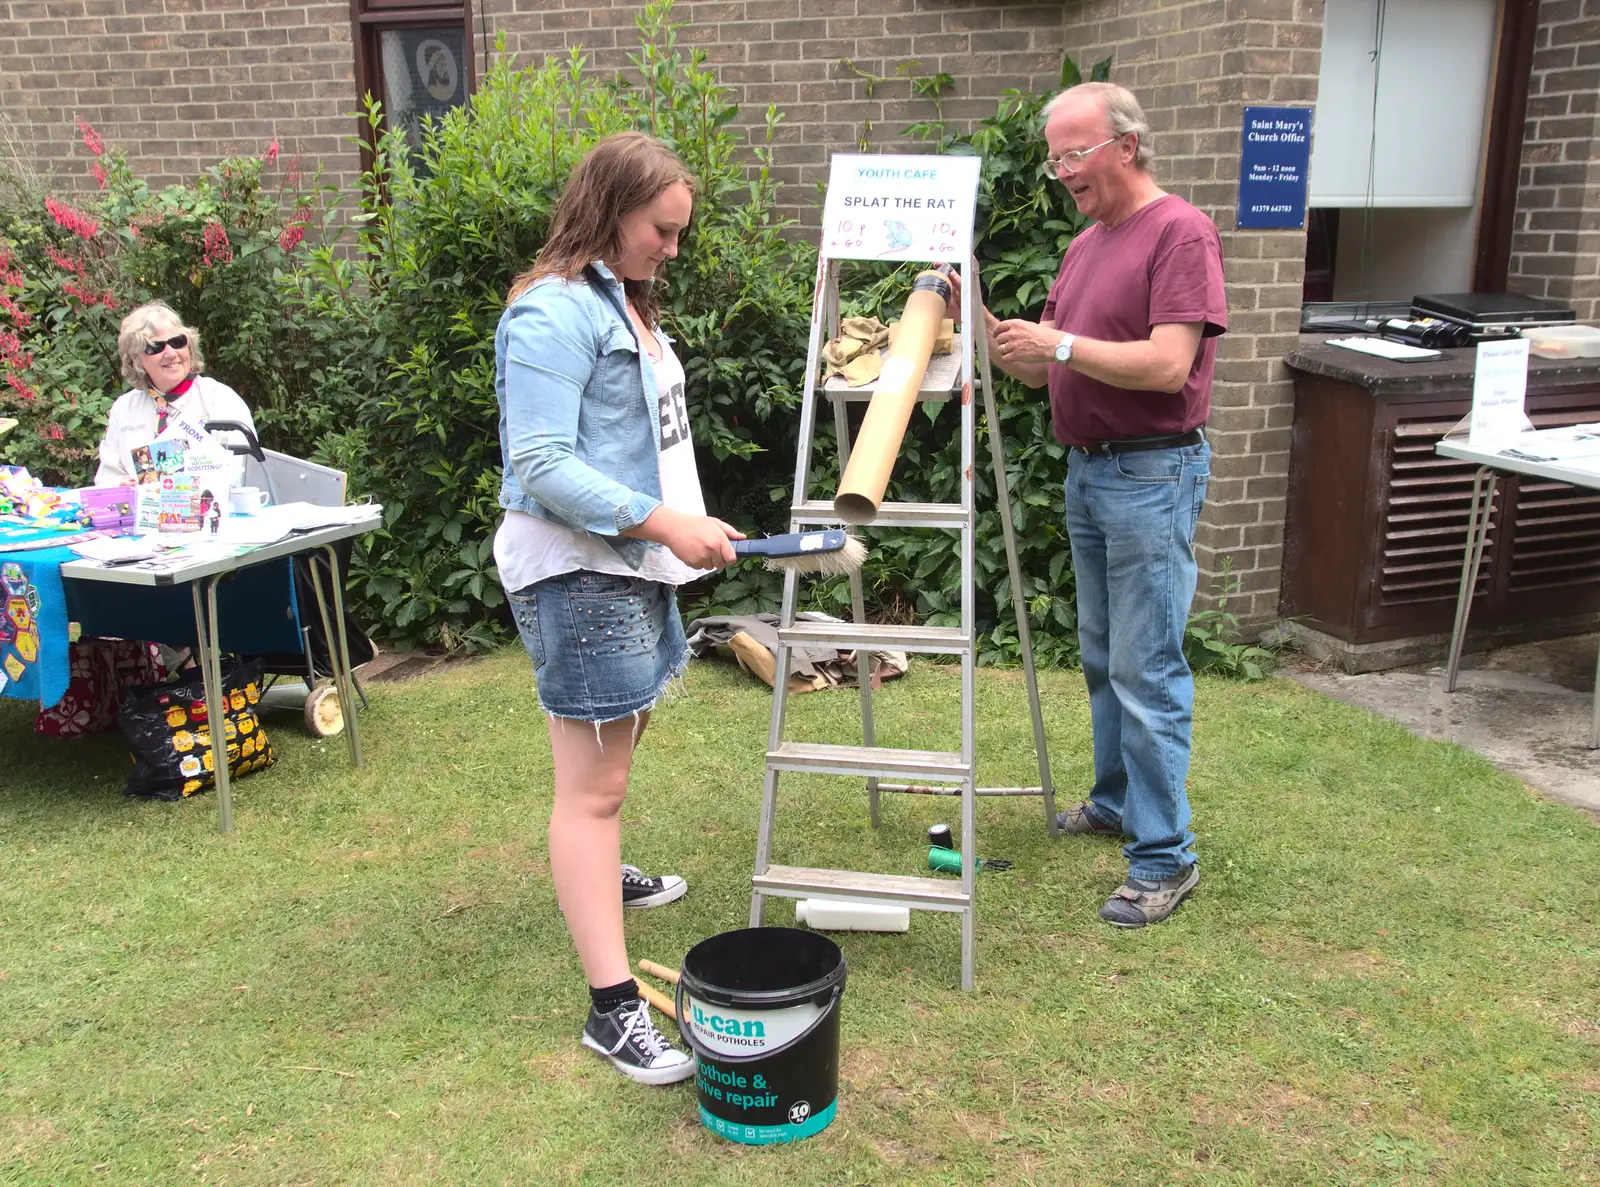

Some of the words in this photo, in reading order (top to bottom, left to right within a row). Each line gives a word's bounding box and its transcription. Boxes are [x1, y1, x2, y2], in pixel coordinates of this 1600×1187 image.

[1251, 120, 1273, 129] Saint
[1275, 120, 1304, 132] Mary's
[1248, 132, 1279, 142] Church
[1280, 133, 1306, 143] Office
[857, 168, 900, 179] YOUTH
[904, 169, 938, 180] CAFE
[1253, 164, 1267, 172] 9am
[1272, 164, 1280, 172] 12
[1248, 173, 1274, 182] Monday
[1279, 174, 1299, 182] Friday
[844, 196, 889, 208] SPLAT
[894, 197, 922, 208] THE
[927, 198, 956, 209] RAT
[178, 421, 203, 442] FROM
[187, 464, 222, 472] SCOUTING?
[691, 1003, 766, 1038] u-can
[694, 1022, 716, 1040] REPAIR
[717, 1034, 765, 1047] POTHOLES
[696, 1056, 747, 1089] Pothole
[753, 1074, 768, 1089] &
[726, 1092, 778, 1110] repair
[790, 1104, 809, 1120] 10
